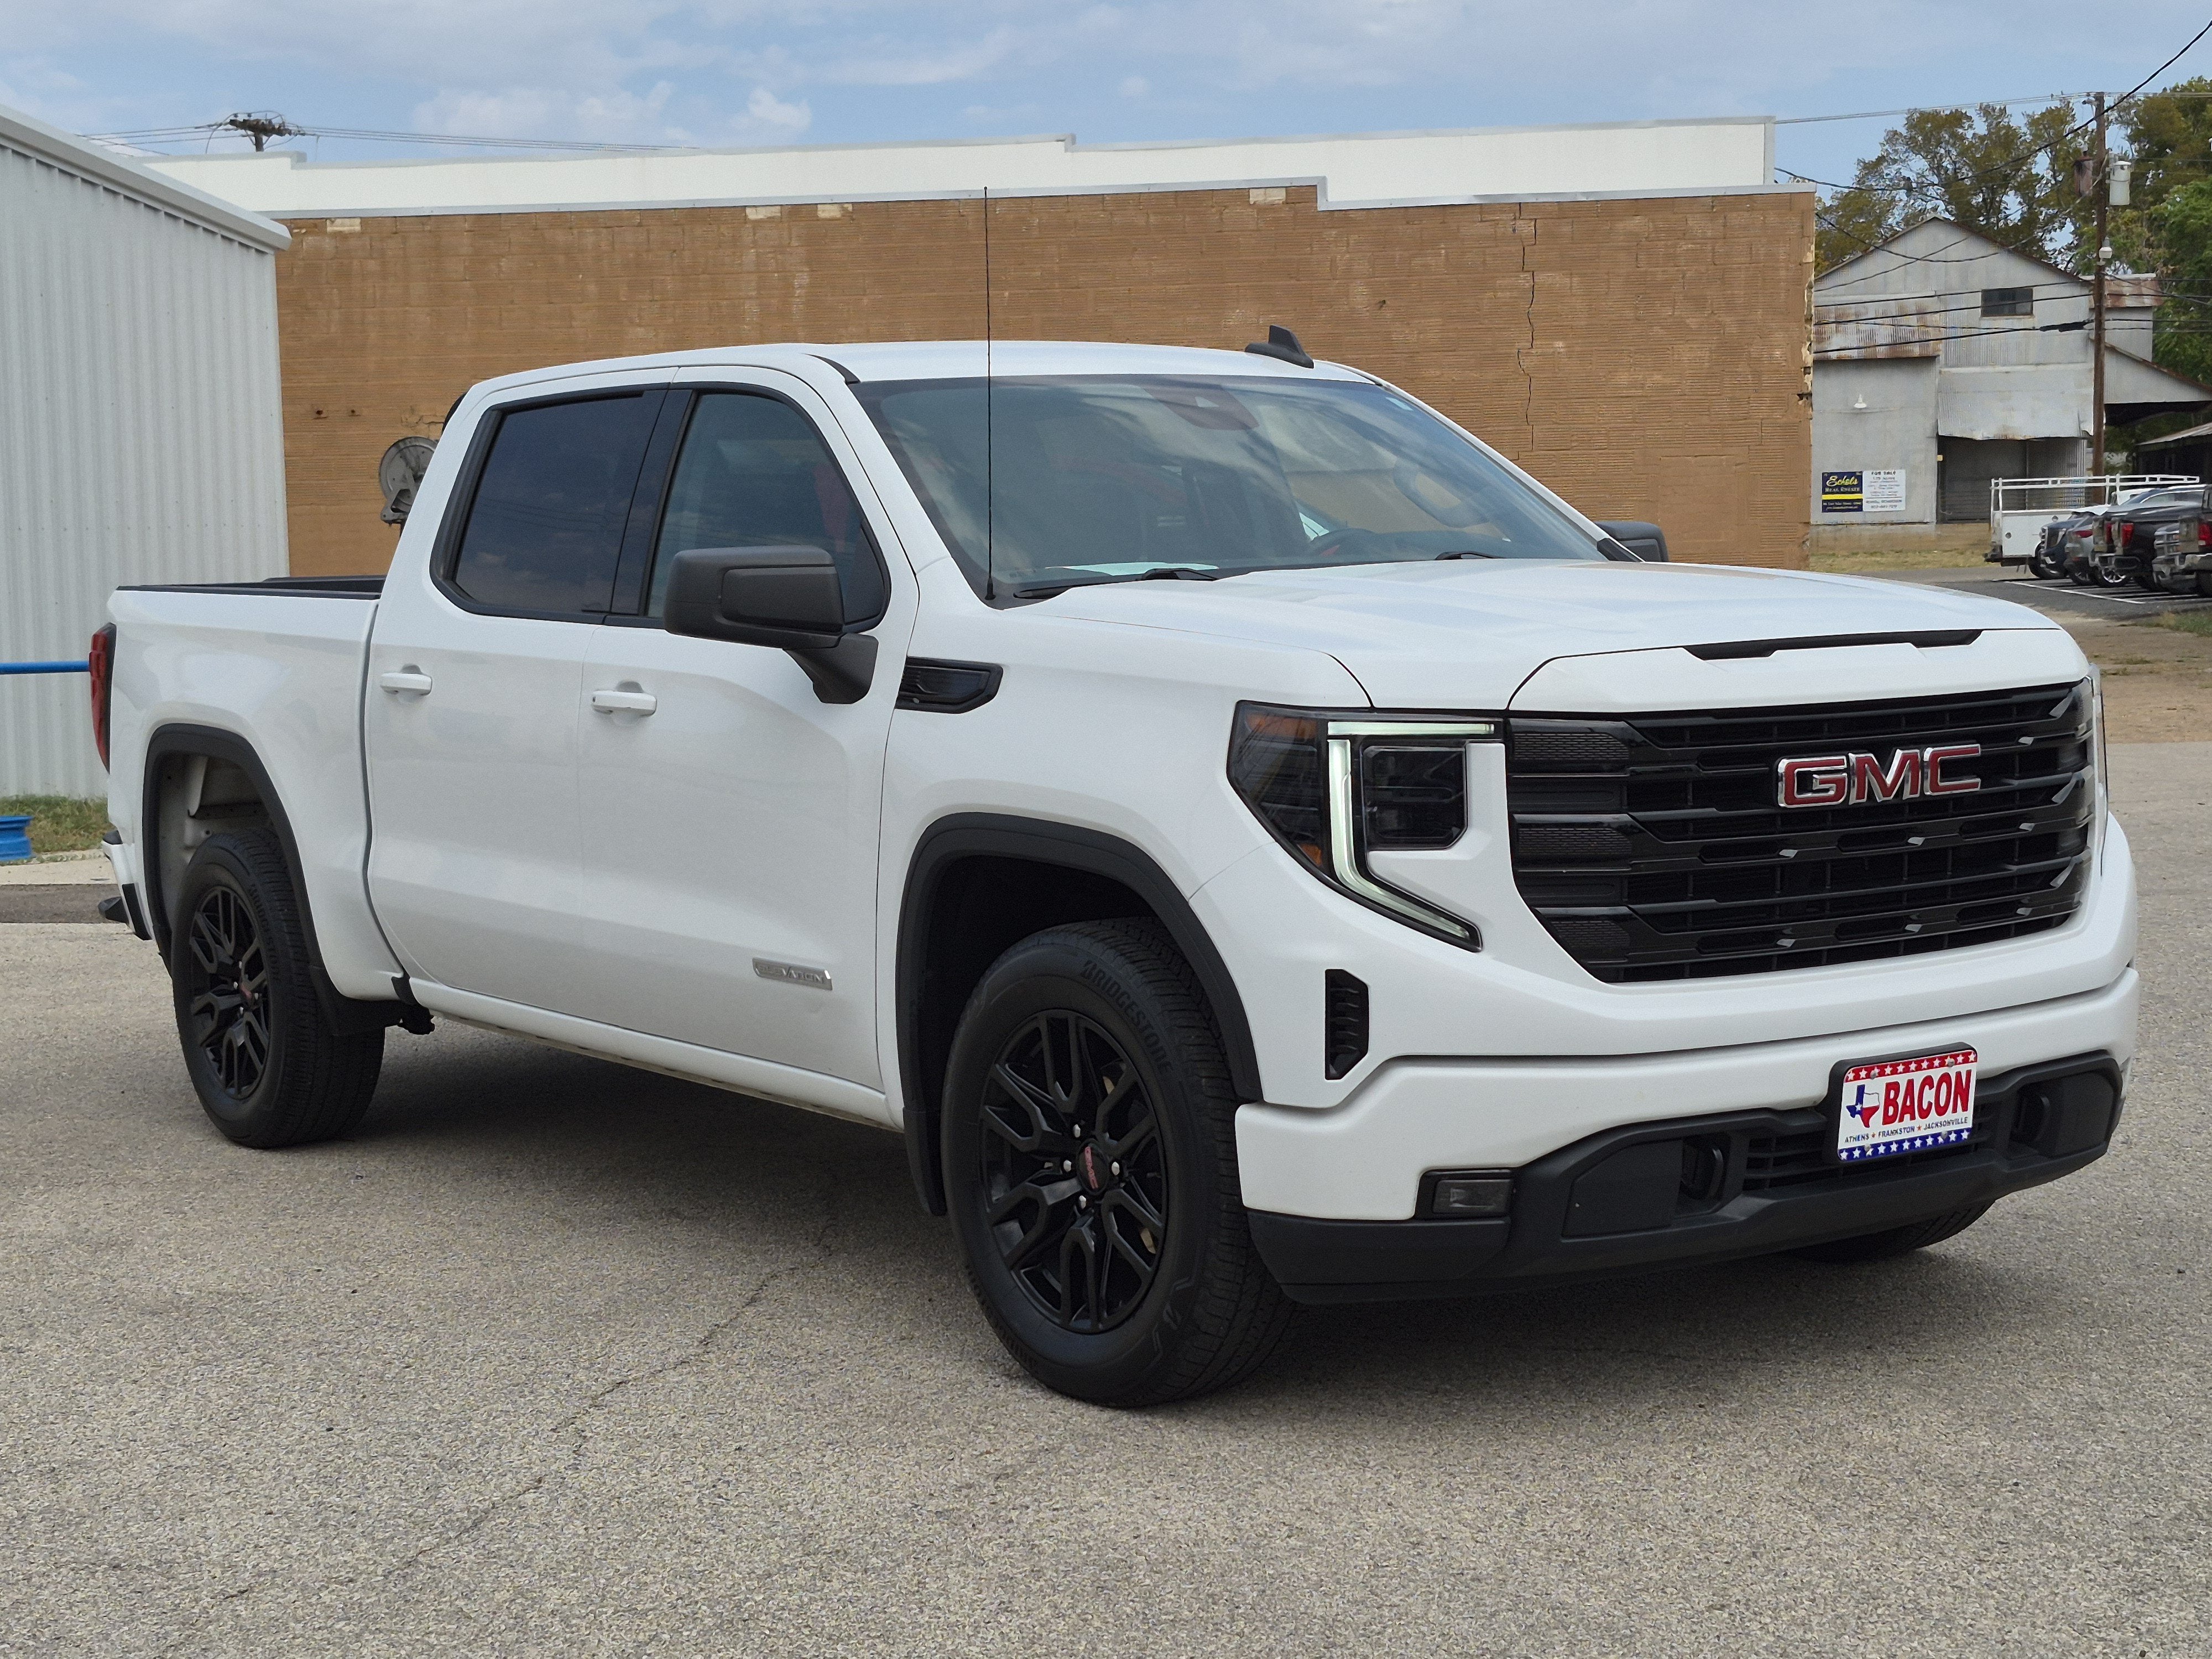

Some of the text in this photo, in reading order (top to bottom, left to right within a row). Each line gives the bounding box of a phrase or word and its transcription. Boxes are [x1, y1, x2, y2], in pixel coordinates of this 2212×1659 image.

[1778, 743, 1981, 808] GMC
[1081, 959, 1174, 1075] BRIDGESTONE
[1882, 1069, 1972, 1125] BACON
[1845, 1117, 1968, 1143] ATHENS FRANKSTON JACKSONVILLE
[1084, 1146, 1099, 1190] GMC
